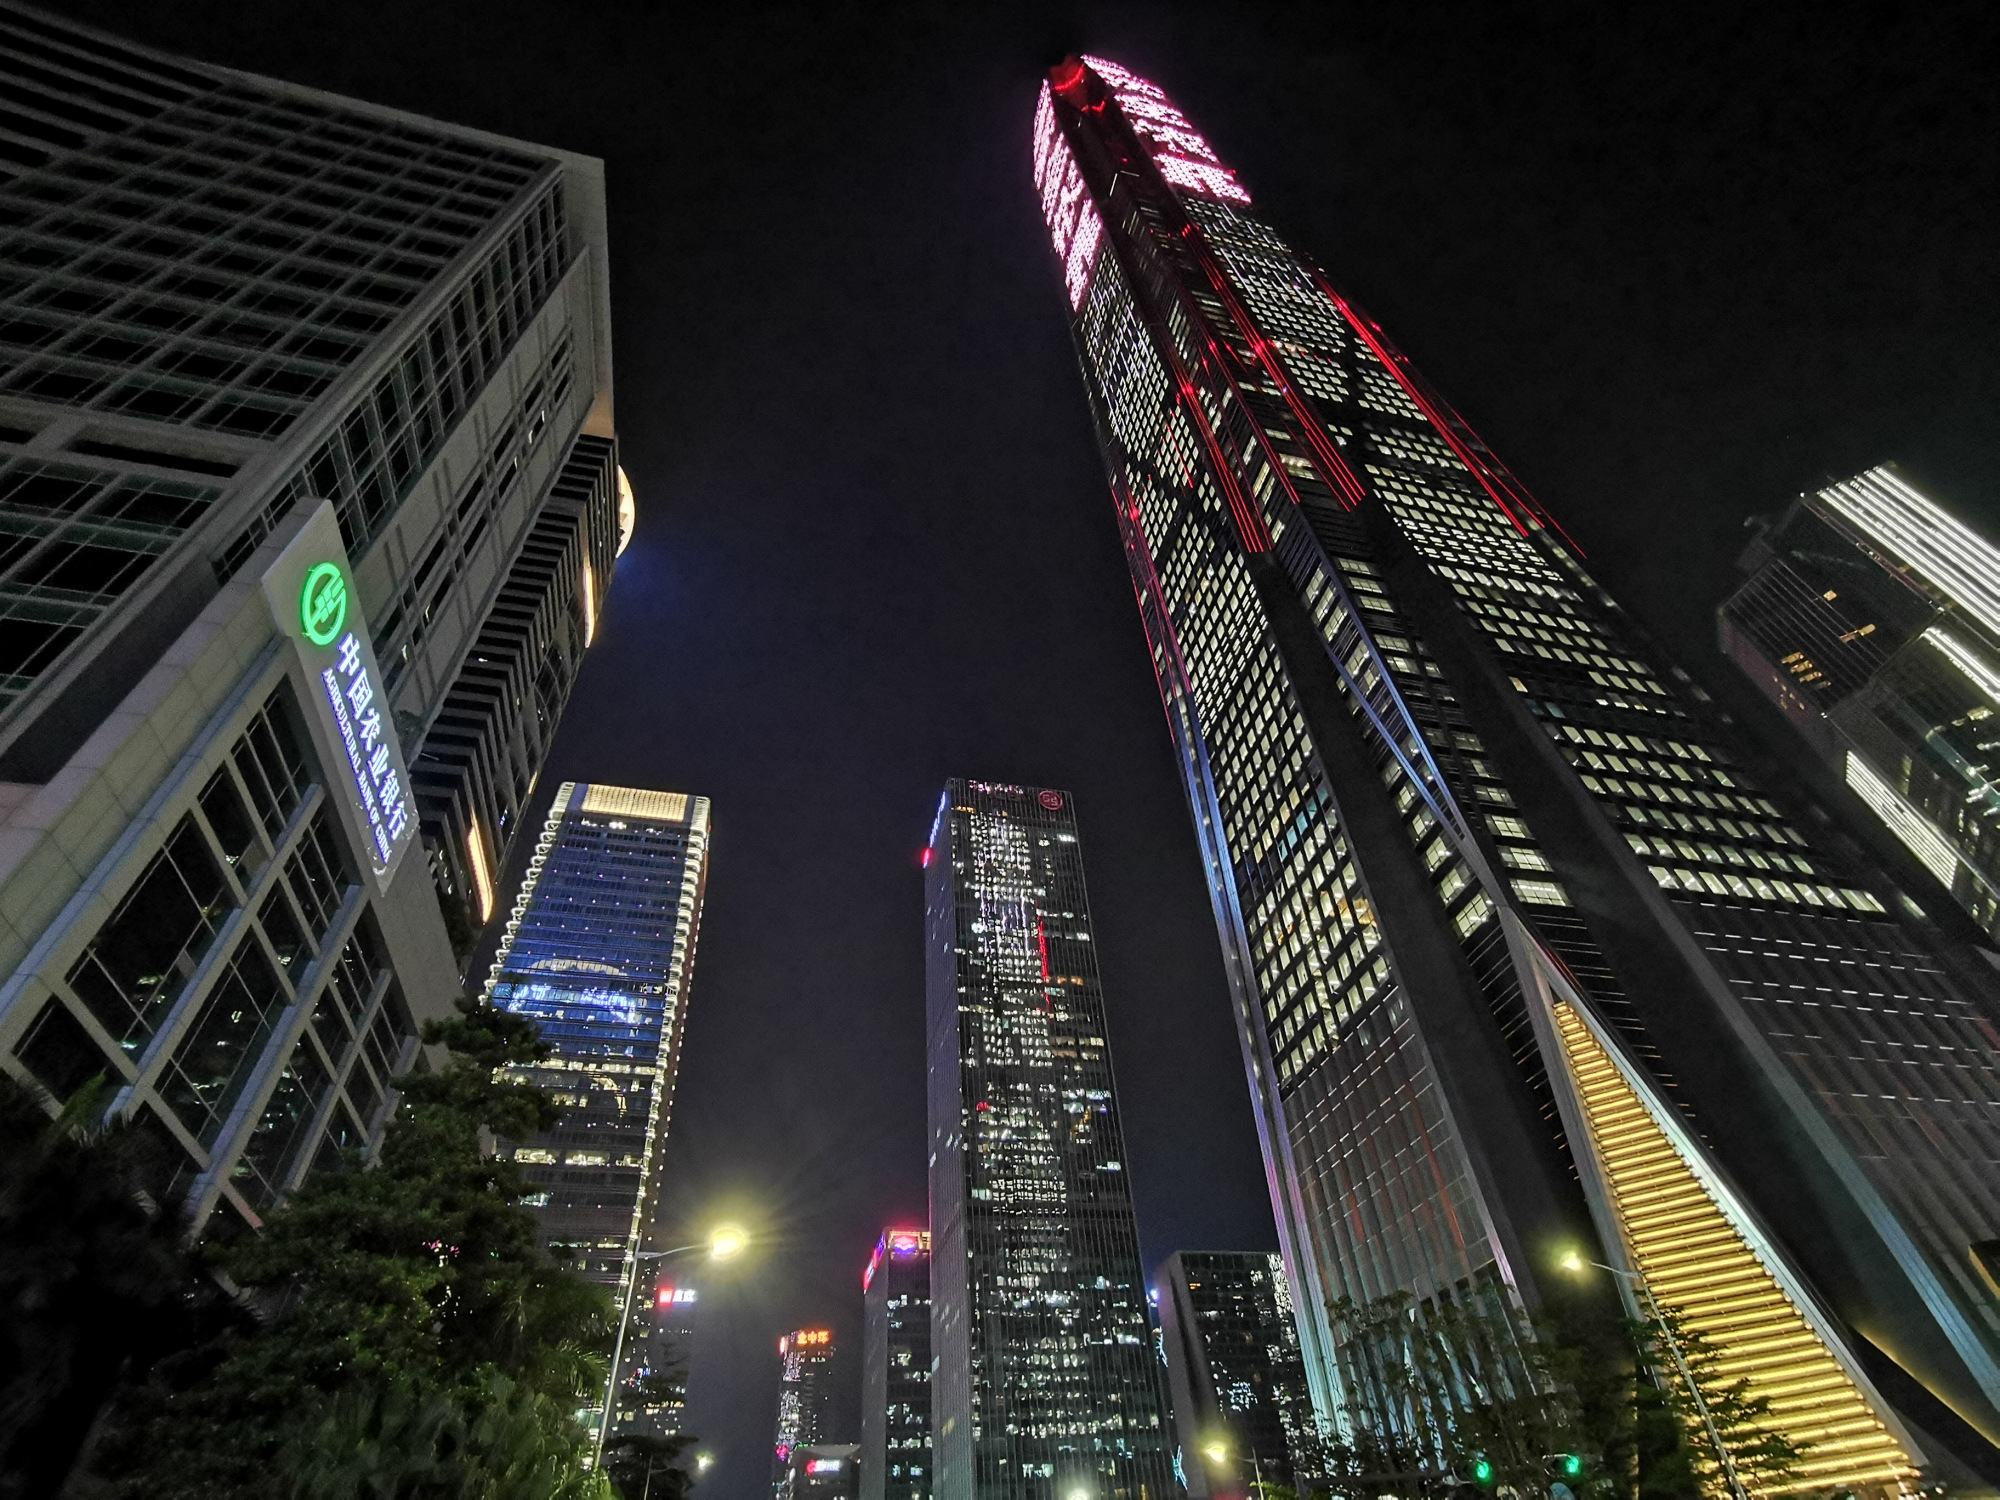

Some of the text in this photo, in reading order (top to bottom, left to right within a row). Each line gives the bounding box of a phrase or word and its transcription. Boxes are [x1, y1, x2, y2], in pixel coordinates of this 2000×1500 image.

[322, 668, 392, 864] AGRICULTURAL BANK OF CHINA
[337, 632, 408, 840] 中国农业银行
